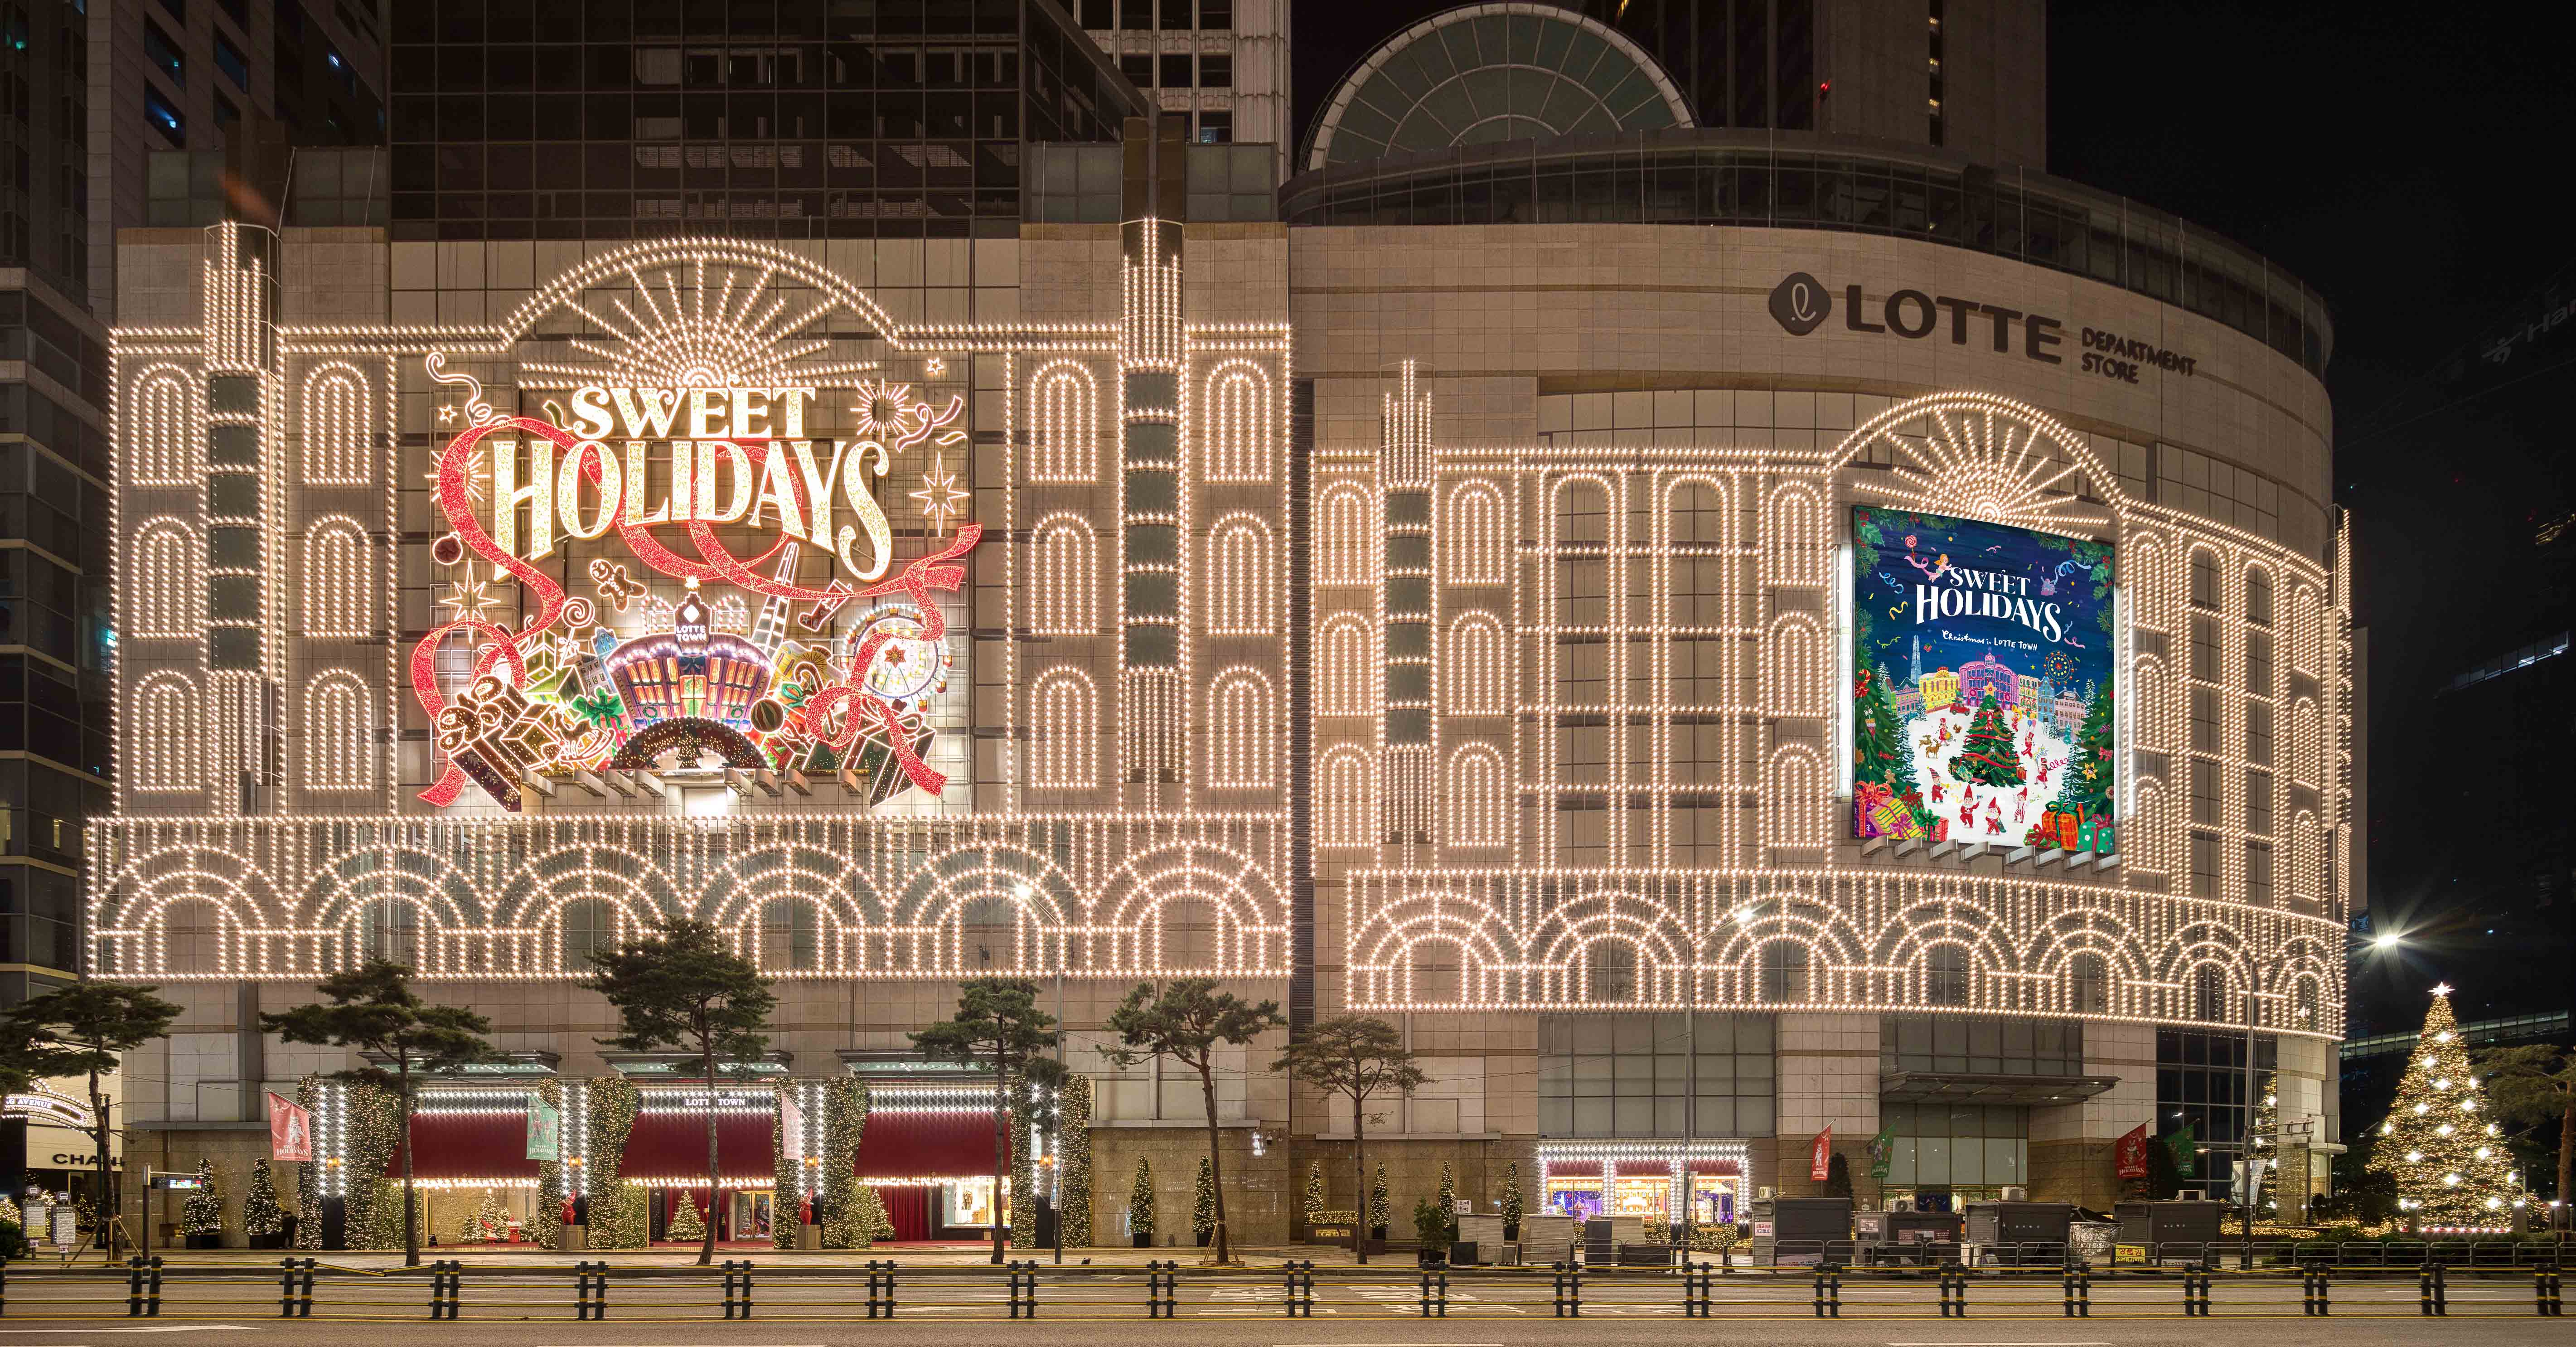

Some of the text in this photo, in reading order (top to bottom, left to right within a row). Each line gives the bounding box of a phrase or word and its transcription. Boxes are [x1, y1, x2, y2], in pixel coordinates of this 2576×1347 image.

[1846, 285, 2062, 364] LOTTE
[2081, 351, 2139, 384] STORE
[2082, 327, 2197, 377] DEPARTMENT
[571, 373, 815, 441] SWEET
[492, 440, 893, 582] HOLIDAYS
[1950, 567, 2030, 596] SWEET
[676, 625, 707, 633] LOTTE
[1916, 584, 2062, 643] HOLIDAYS
[676, 633, 707, 642] TOWN
[1942, 630, 1985, 644] Christmas
[1994, 637, 2016, 648] LOTTE
[2018, 641, 2038, 651] TOWN
[2118, 1247, 2142, 1256] 상품권
